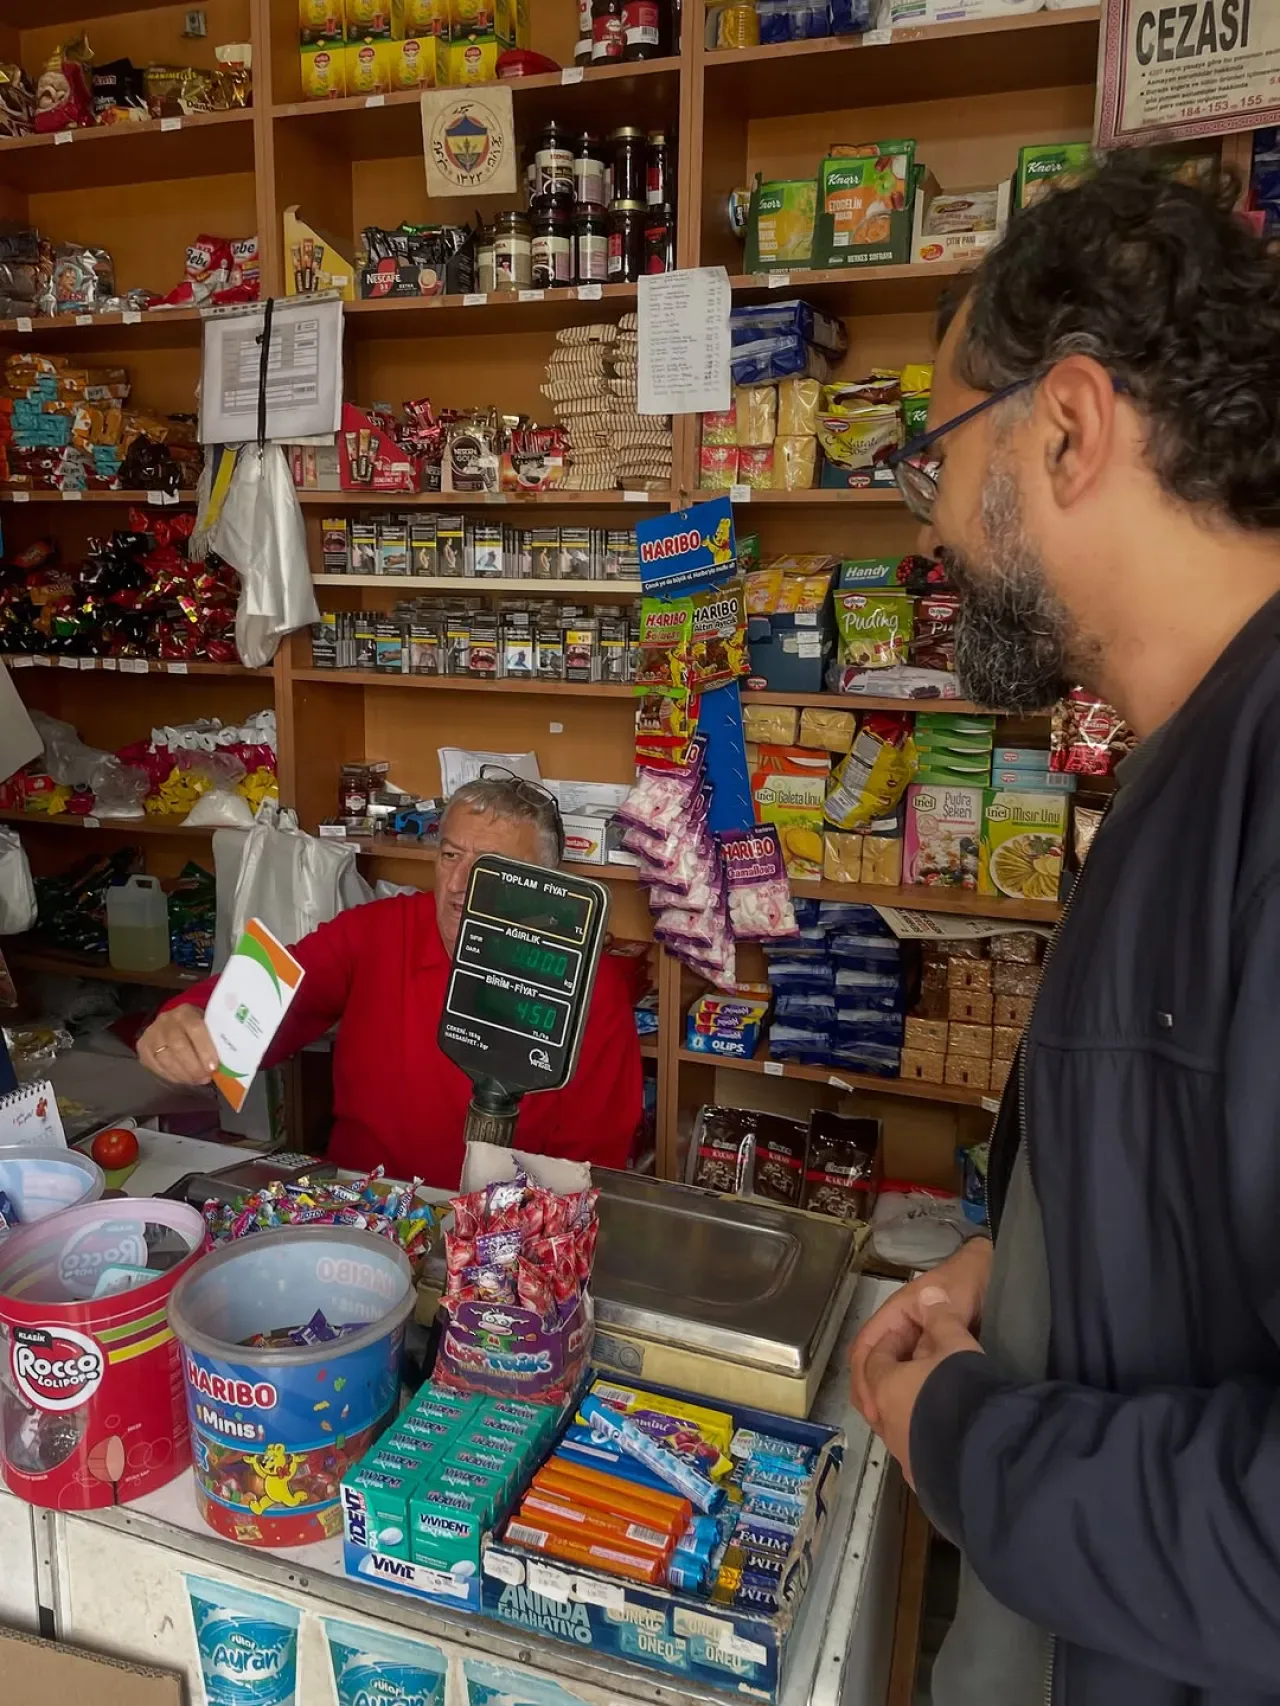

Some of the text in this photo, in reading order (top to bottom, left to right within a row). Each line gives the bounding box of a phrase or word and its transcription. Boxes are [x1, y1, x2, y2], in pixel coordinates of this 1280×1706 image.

[1136, 0, 1250, 66] CEZASI
[1027, 160, 1063, 173] Knorr
[828, 173, 860, 186] Knorr
[641, 529, 701, 563] HARIBO
[846, 564, 890, 578] Handy
[645, 610, 687, 627] HARIBO
[692, 597, 738, 624] HARIBO
[842, 608, 899, 634] Puding
[778, 789, 804, 805] Galeta
[945, 792, 972, 808] Pudra
[1042, 807, 1060, 823] Unu
[721, 836, 775, 861] HARIBO
[501, 871, 569, 898] TOPLAM FİYAT
[505, 926, 541, 946] AĞIRLIK
[187, 1358, 277, 1410] HARIBO
[203, 1406, 257, 1439] Minis
[751, 1467, 797, 1487] FALIM
[750, 1498, 797, 1518] FALIM
[740, 1529, 789, 1551] FALIM
[499, 1584, 591, 1629] ANINDA
[638, 1634, 674, 1657] ONEO
[213, 1643, 280, 1674] Ayran
[705, 1645, 742, 1671] ONEO
